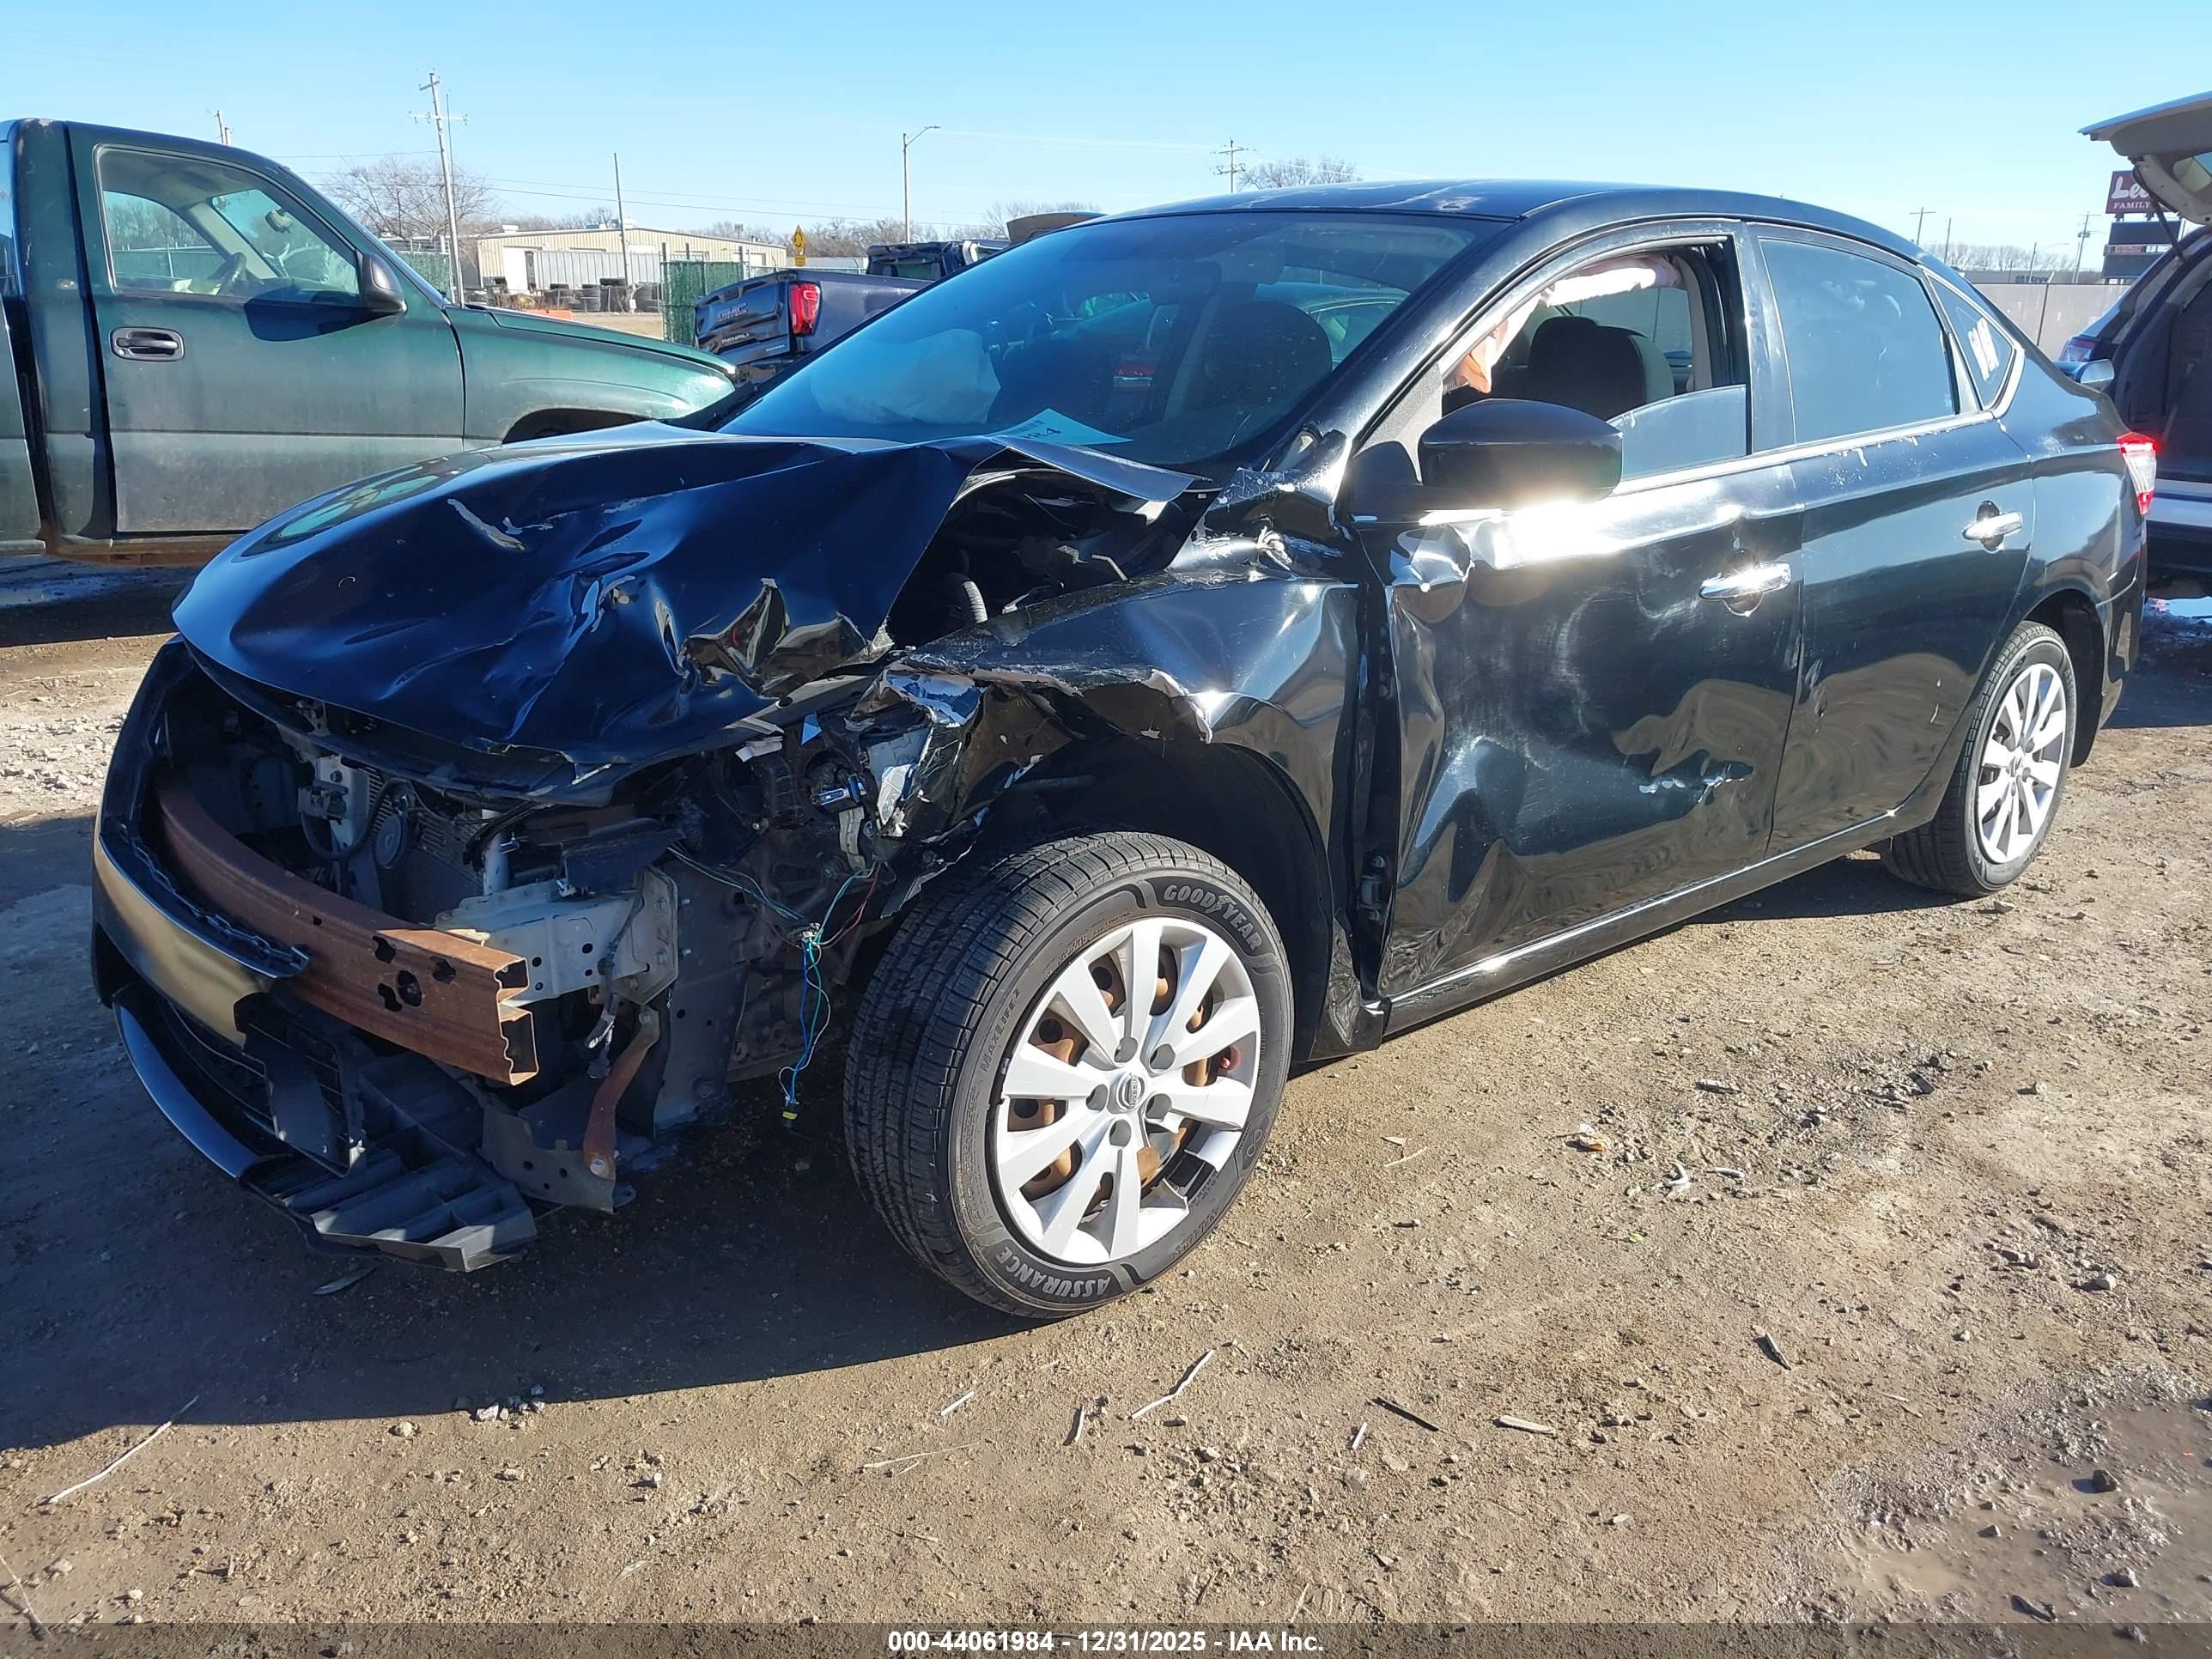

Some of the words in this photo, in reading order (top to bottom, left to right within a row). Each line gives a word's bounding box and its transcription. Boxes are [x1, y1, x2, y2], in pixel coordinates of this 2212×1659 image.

[2113, 201, 2151, 210] FAMILY
[1164, 884, 1263, 951] GOODYEAR
[980, 1000, 1016, 1073] MAXLIFE
[995, 1247, 1111, 1297] ASSURANCE
